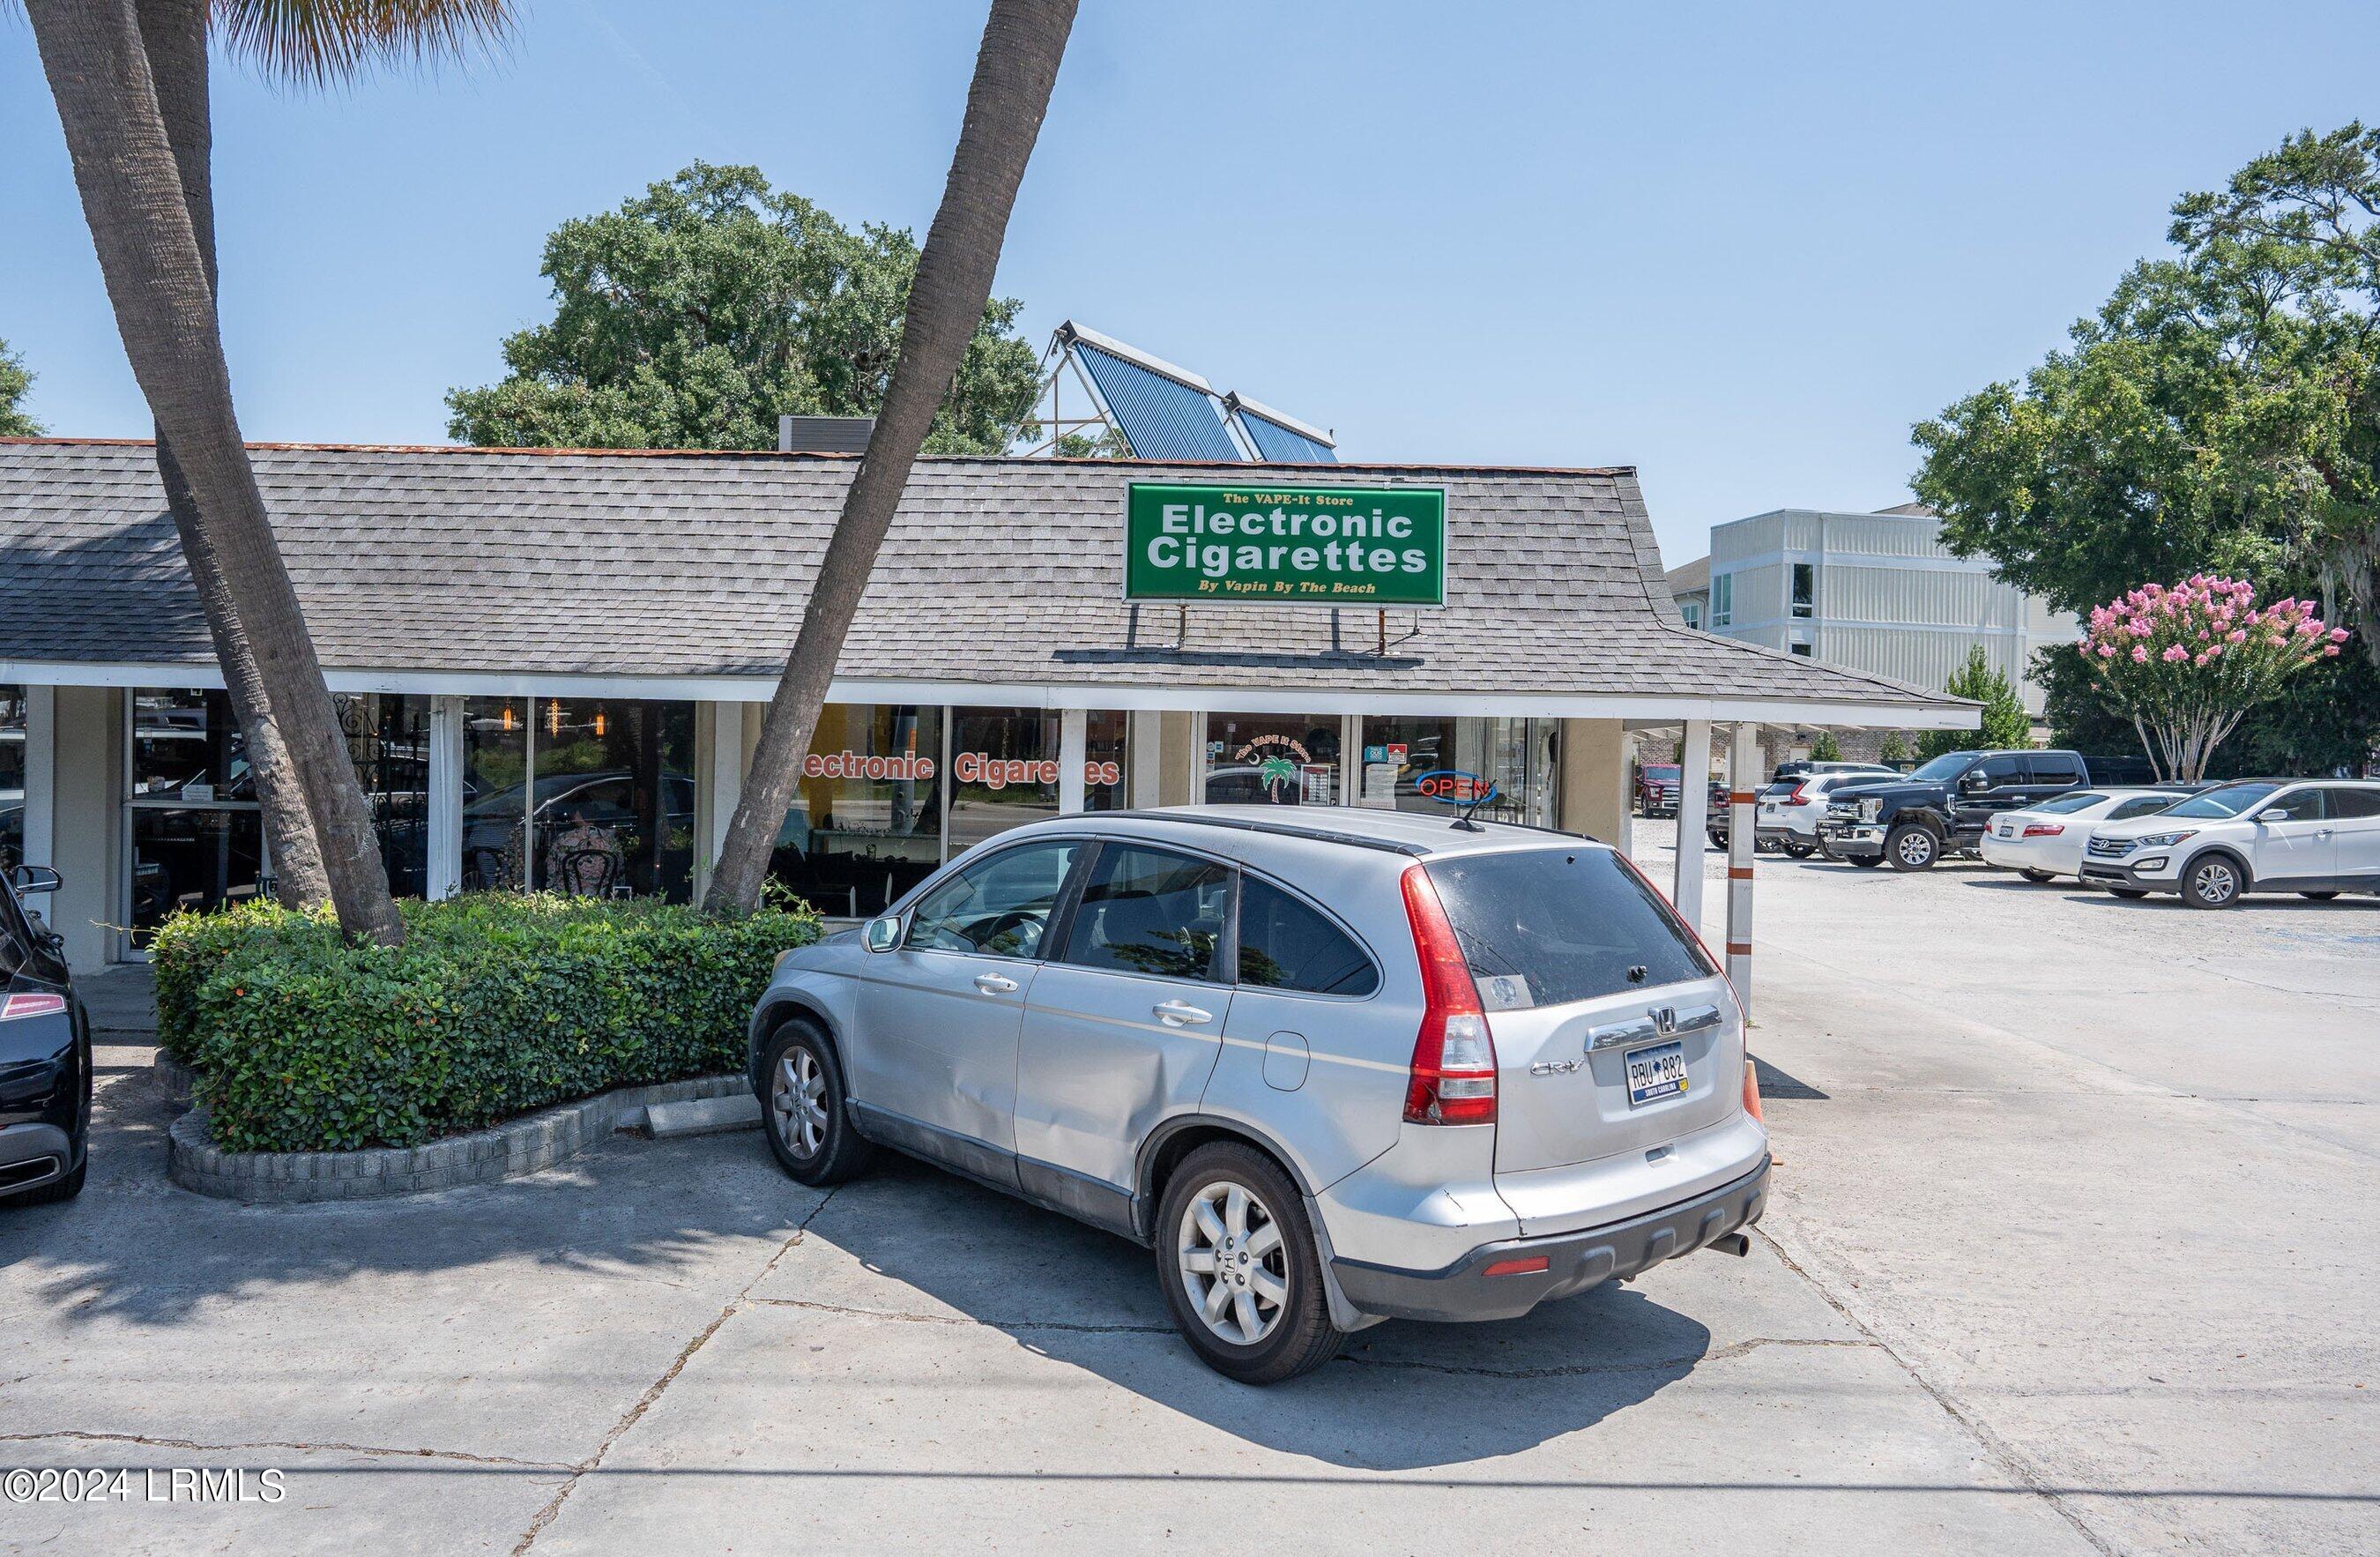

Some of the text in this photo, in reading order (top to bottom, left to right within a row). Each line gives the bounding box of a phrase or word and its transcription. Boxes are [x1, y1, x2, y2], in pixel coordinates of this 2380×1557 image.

[1223, 494, 1353, 505] The VAPE-It Store
[1162, 504, 1413, 538] Electronic
[1147, 536, 1427, 577] Cigarettes
[1198, 580, 1375, 593] By Vapin By The Beach
[1234, 744, 1253, 760] The
[1251, 734, 1279, 747] VAPE
[1290, 740, 1312, 764] Store
[803, 750, 1119, 790] ectronic Cigarees
[1420, 779, 1490, 800] OPEN
[1632, 1054, 1684, 1088] RBU 882
[1645, 1087, 1658, 1097] SOUTH
[1658, 1082, 1677, 1094] CAROLINA
